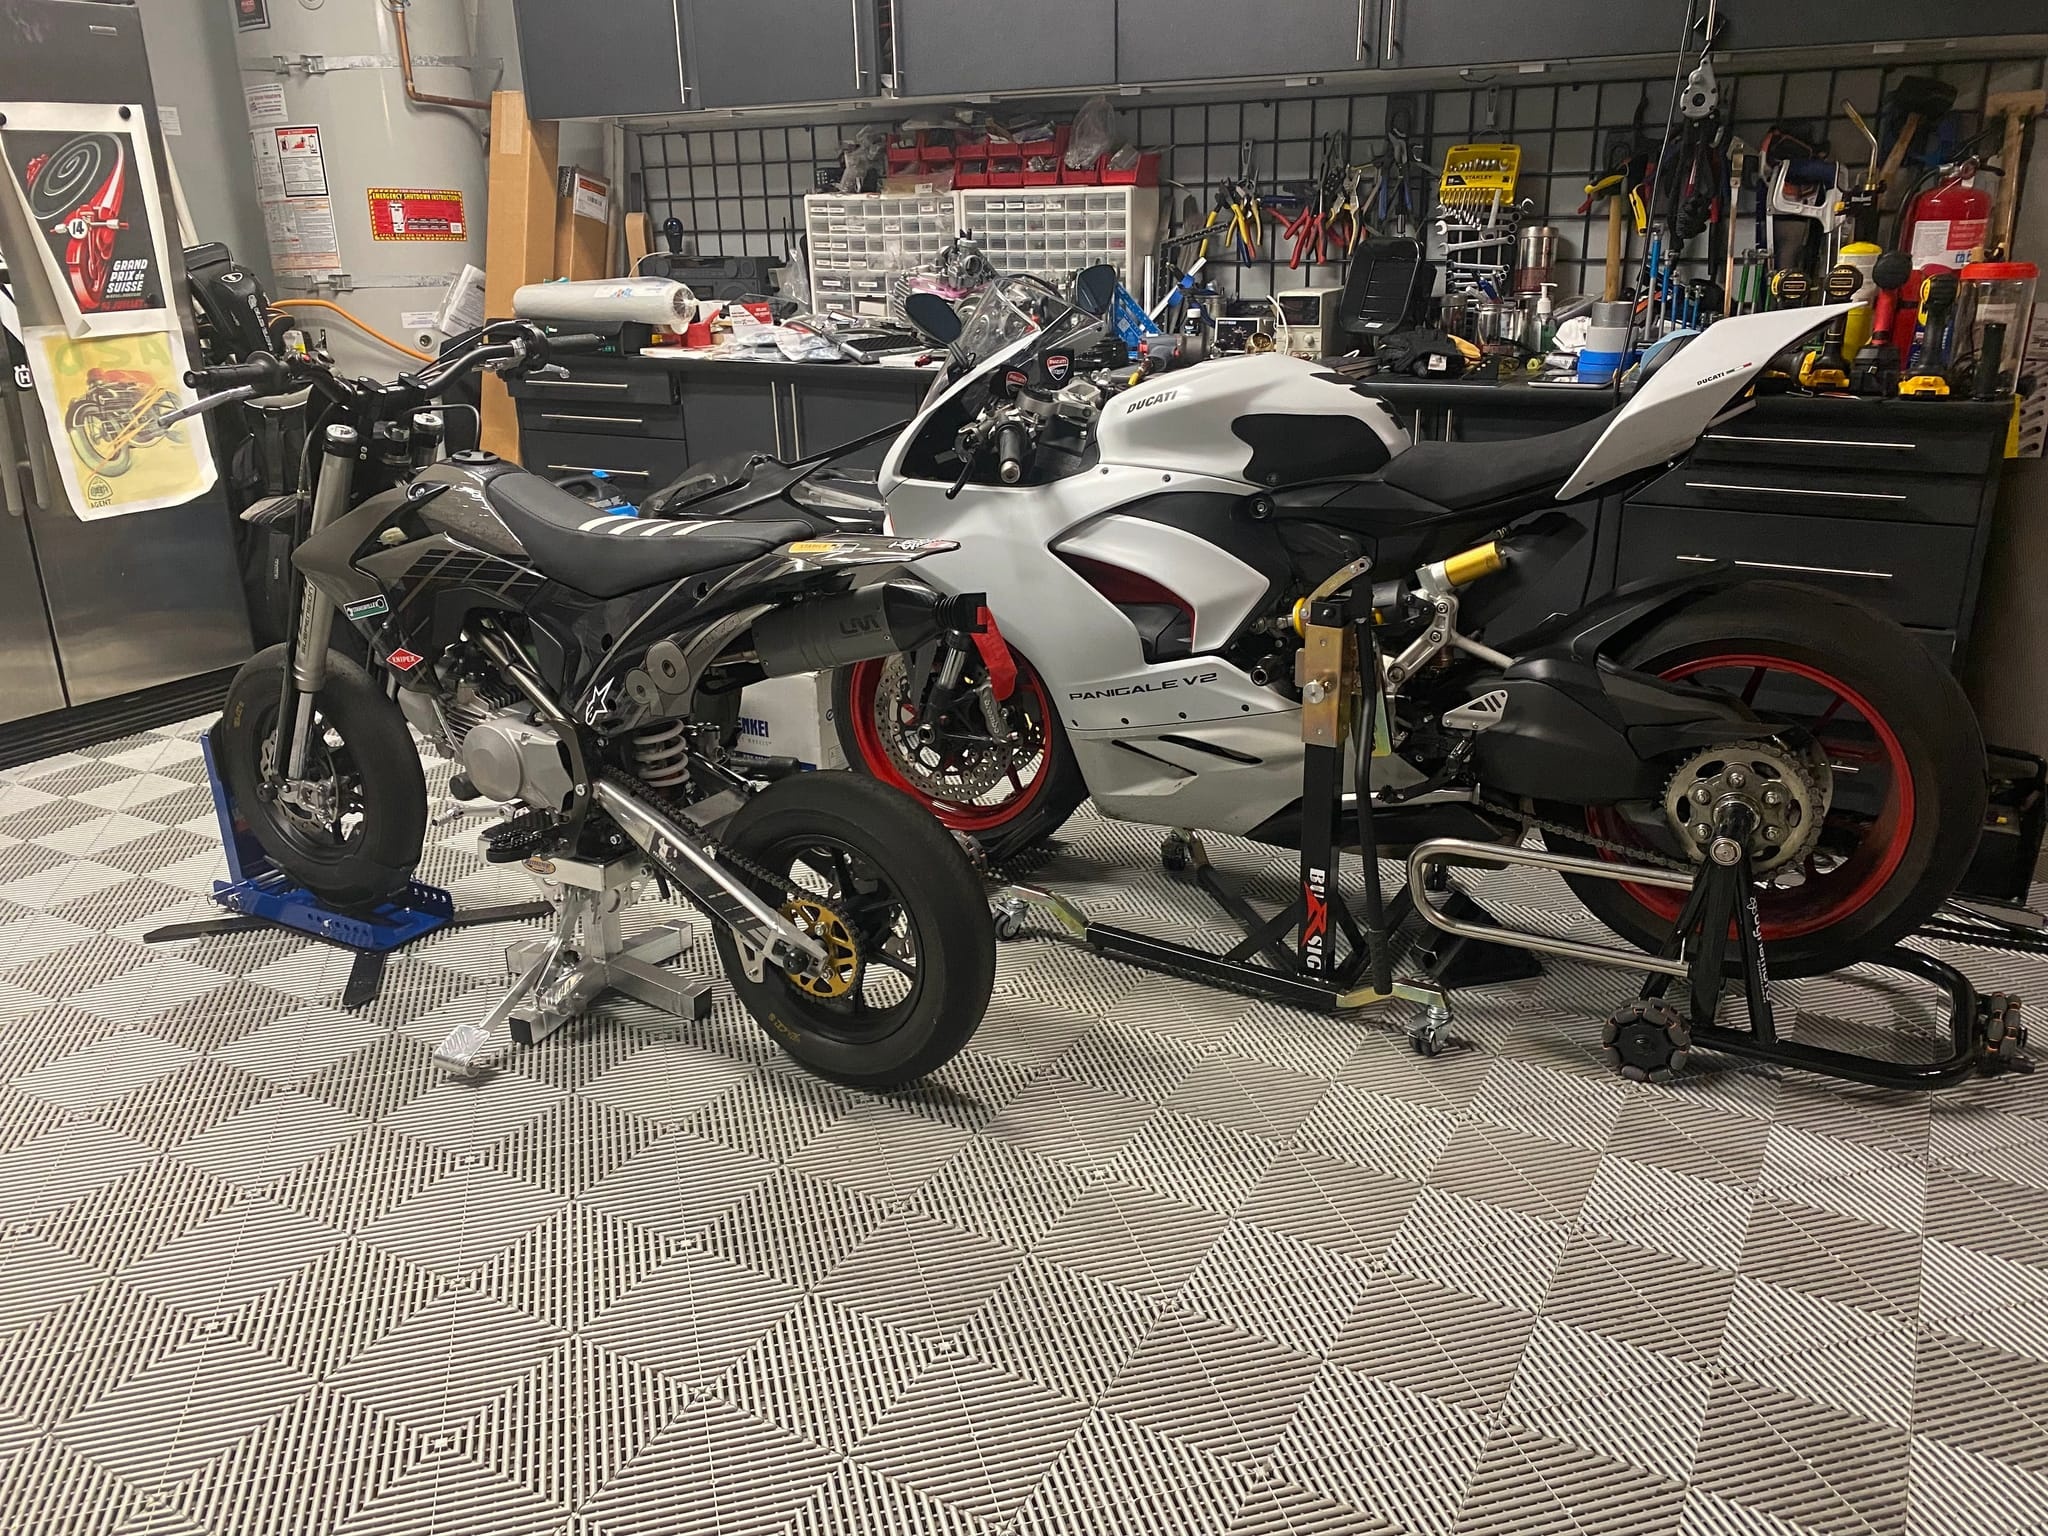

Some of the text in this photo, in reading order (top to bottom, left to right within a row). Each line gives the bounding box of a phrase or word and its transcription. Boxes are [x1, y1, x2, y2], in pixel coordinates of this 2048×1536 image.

[372, 192, 402, 200] EMERGENCY
[72, 220, 85, 235] 14
[113, 259, 148, 271] GRAND
[109, 270, 144, 282] PRIX de
[106, 281, 143, 293] SUISSE
[1696, 372, 1725, 386] DUCATI
[1126, 390, 1178, 415] DUCATI
[90, 499, 111, 508] AGENT
[391, 655, 416, 664] KNIPEX
[1069, 672, 1218, 701] PANIGALE V2
